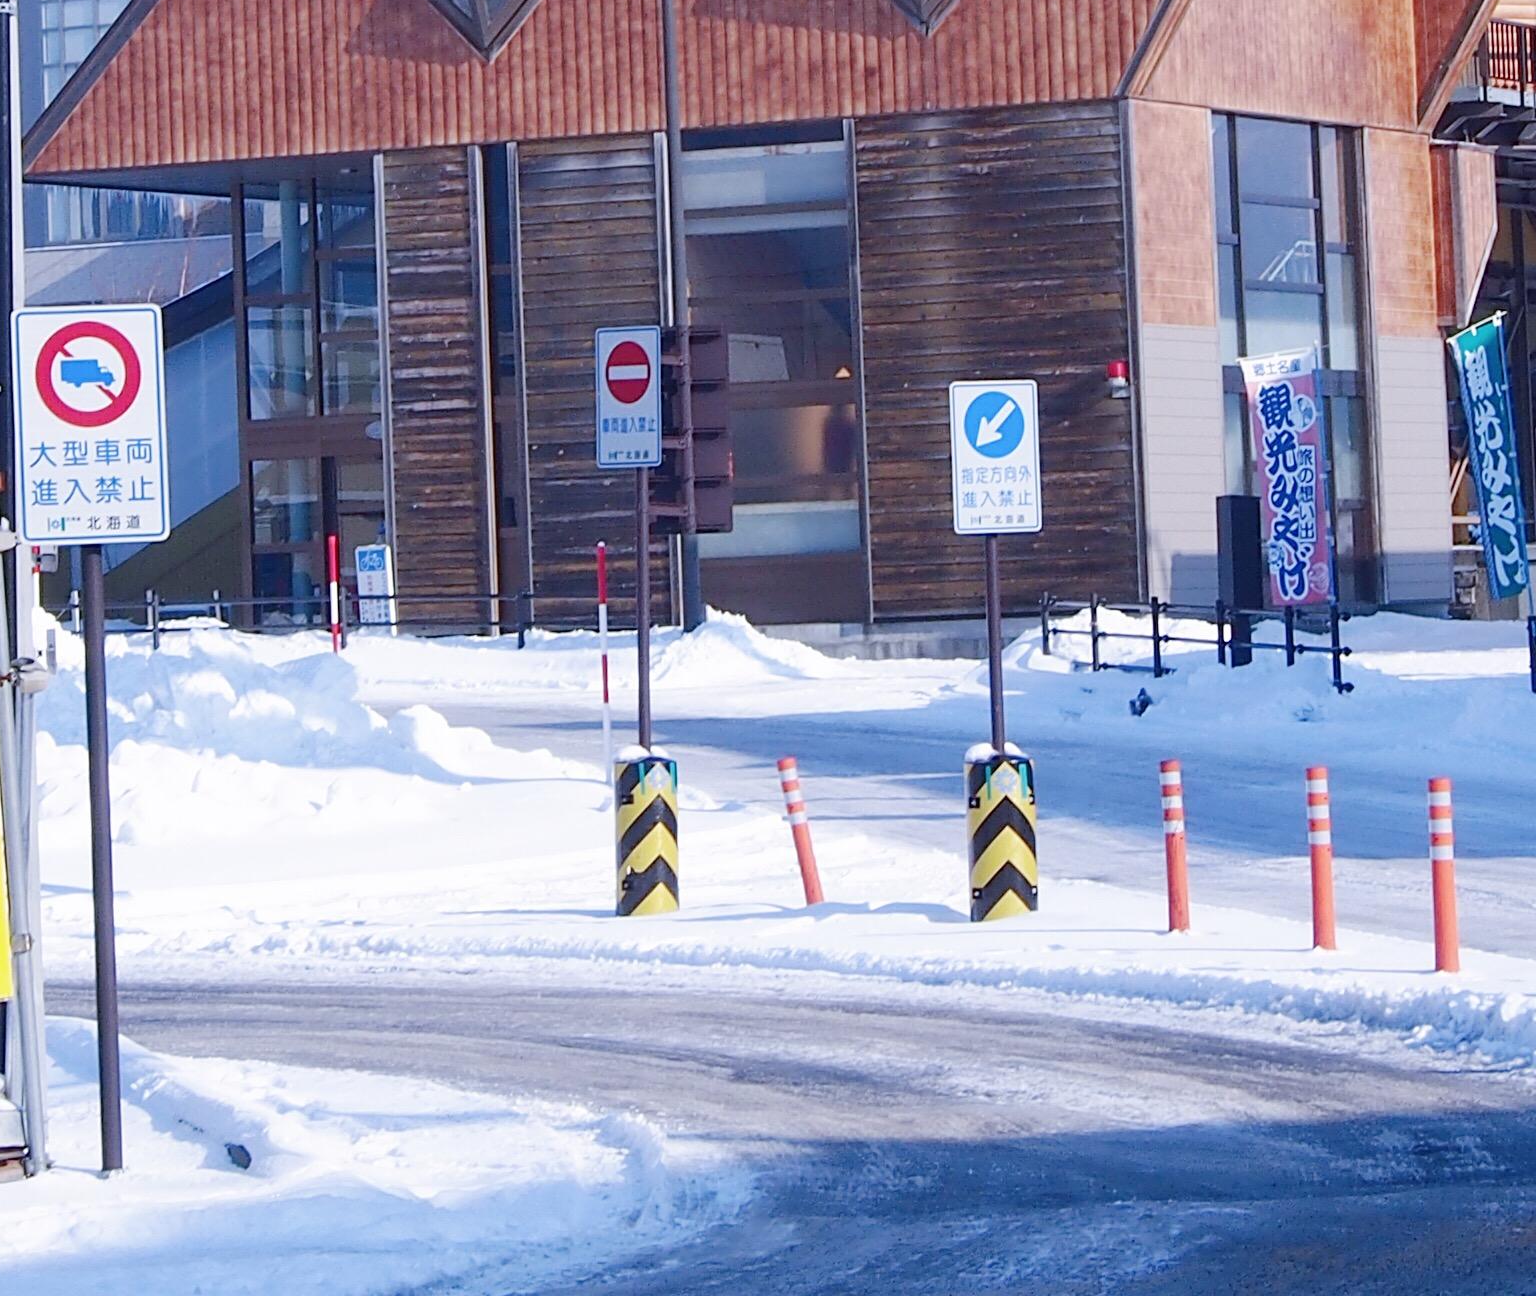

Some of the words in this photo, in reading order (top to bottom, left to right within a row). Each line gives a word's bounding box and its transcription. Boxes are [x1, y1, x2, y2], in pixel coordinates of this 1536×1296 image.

[30, 438, 153, 468] 大型車両
[961, 465, 1032, 485] 指定方向外
[31, 475, 156, 506] 進入禁止
[962, 490, 1033, 509] 進入禁止
[1258, 382, 1311, 599] 観光みやげ
[1299, 448, 1315, 541] 旅の想い出
[86, 515, 141, 531] 北海道
